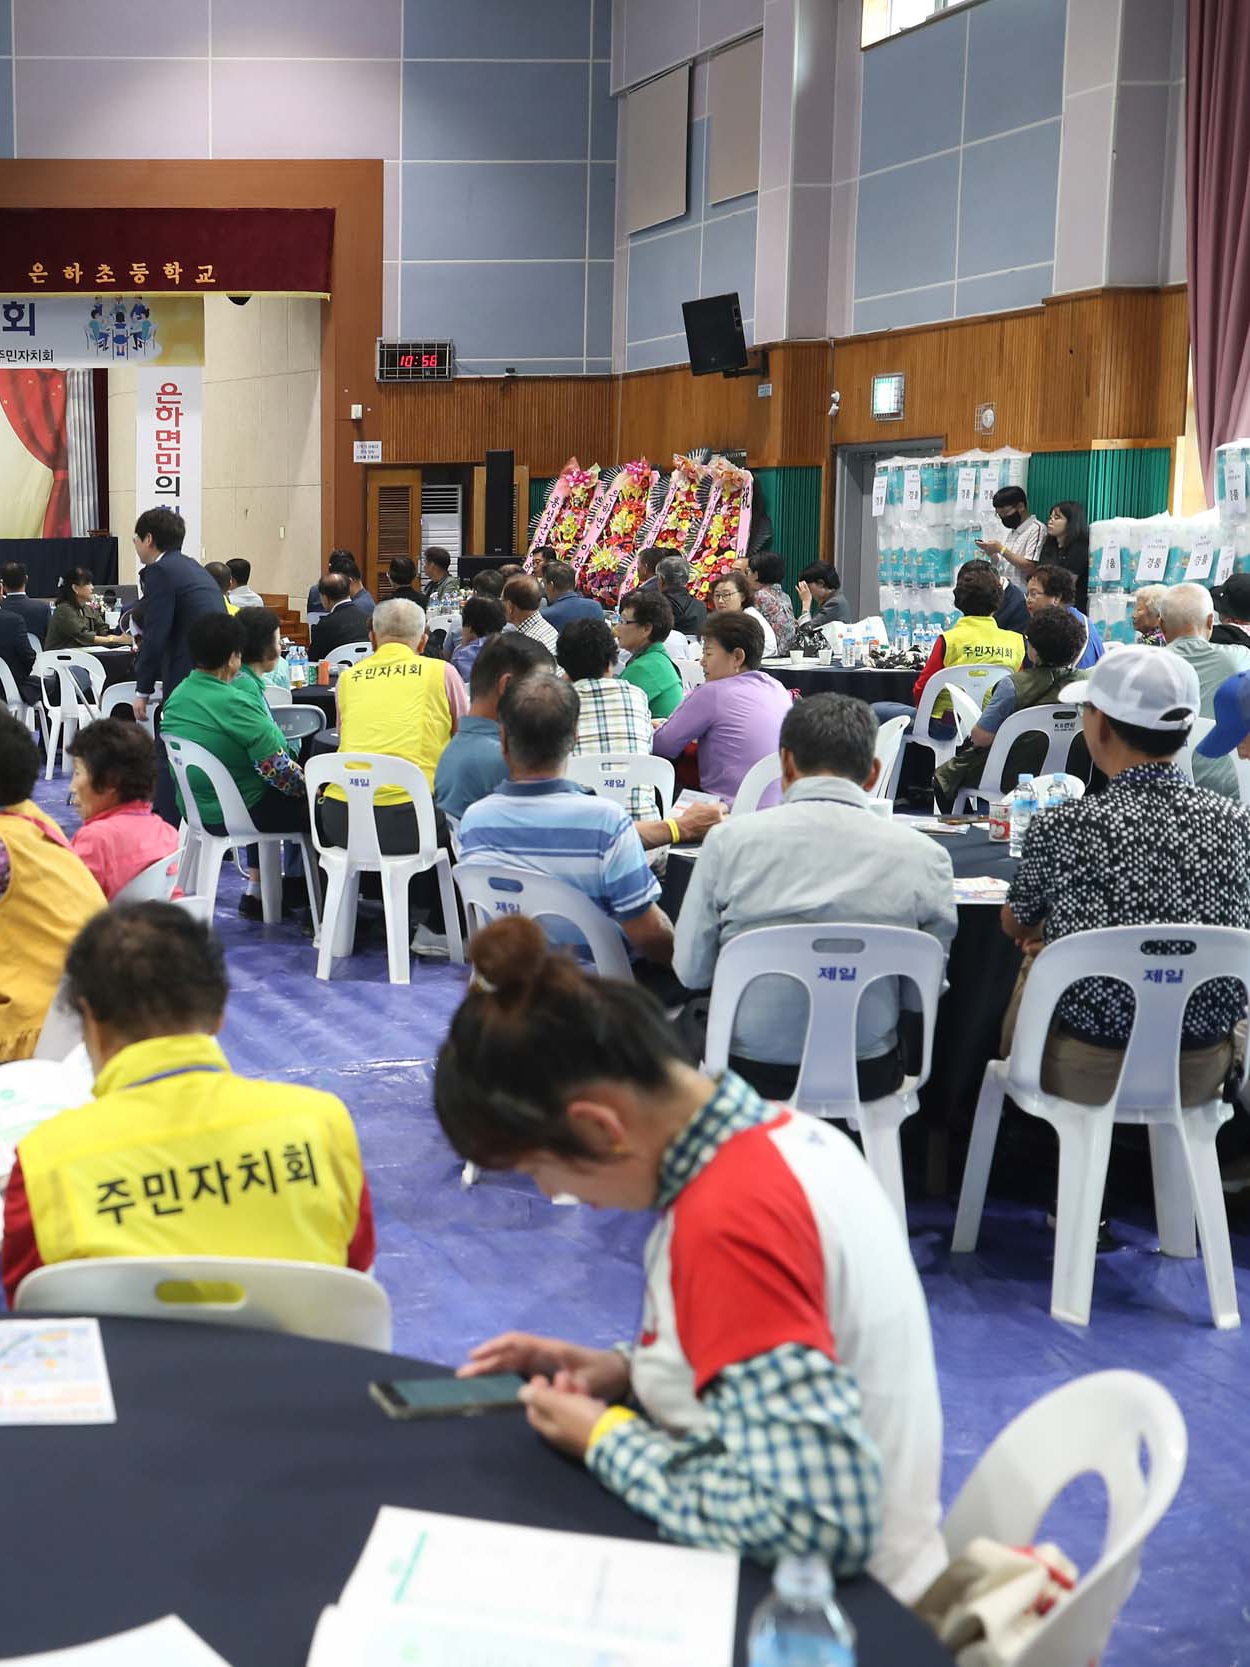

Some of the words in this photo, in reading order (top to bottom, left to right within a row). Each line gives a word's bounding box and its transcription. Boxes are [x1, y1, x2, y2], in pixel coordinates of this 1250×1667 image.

[27, 261, 216, 285] 은하초등학교
[155, 382, 184, 497] 은하면민의
[963, 645, 1013, 659] 주민자치회
[351, 663, 422, 682] 주민자치회
[349, 777, 370, 787] 제일
[603, 779, 626, 788] 제일
[817, 966, 857, 981] 제일
[1142, 968, 1184, 984] 제일
[96, 1141, 319, 1226] 주민자치회
